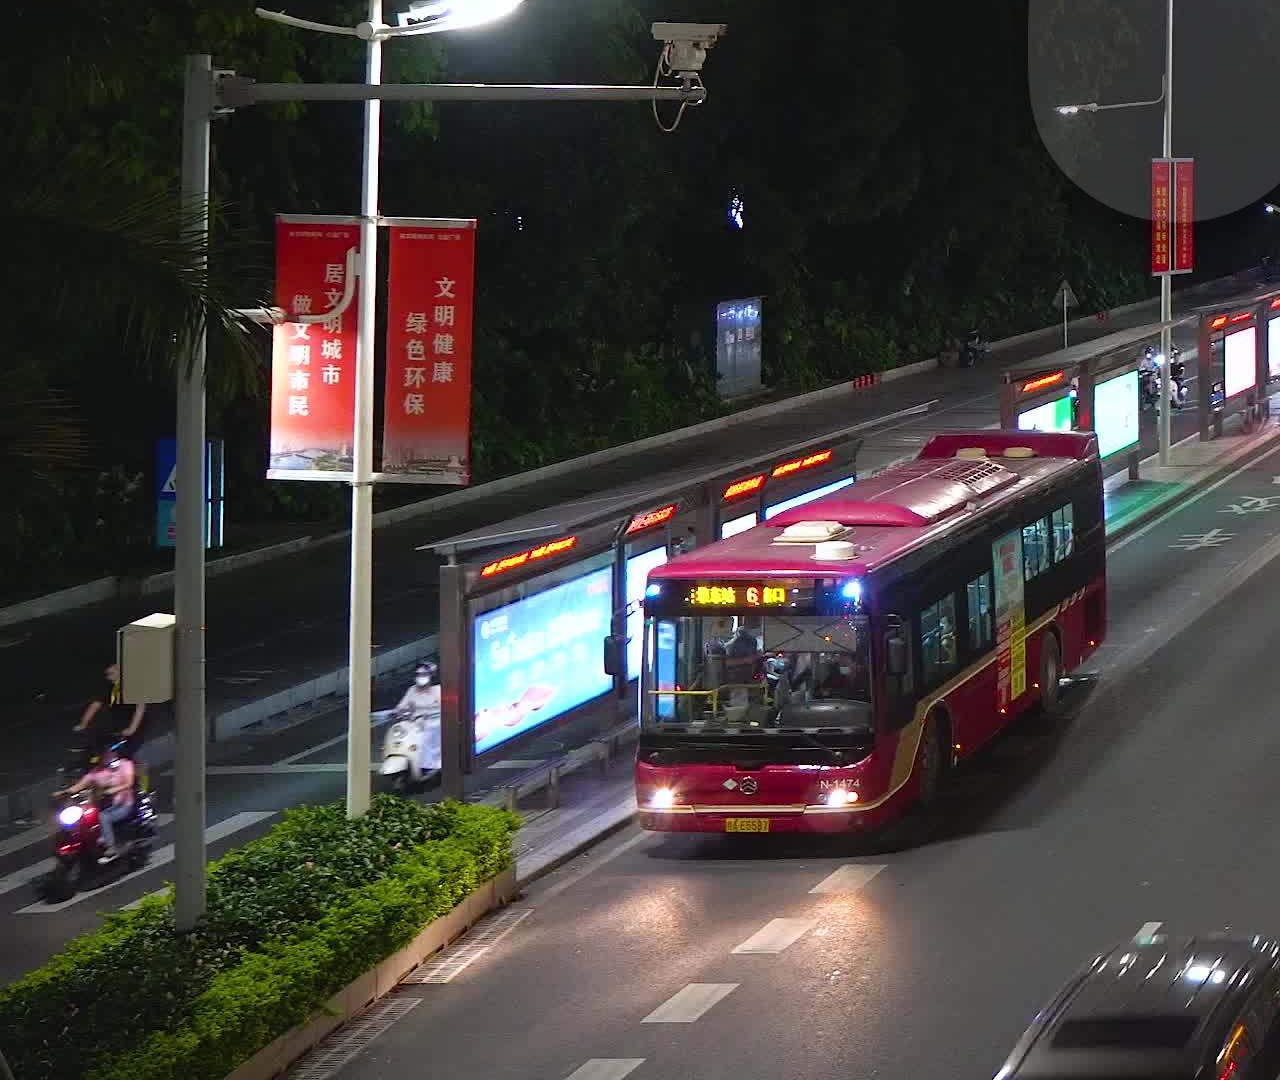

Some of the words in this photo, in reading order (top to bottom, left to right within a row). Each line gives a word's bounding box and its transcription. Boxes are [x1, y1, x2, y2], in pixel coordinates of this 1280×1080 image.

[287, 294, 313, 417] 做文明市民
[321, 263, 344, 385] 居文明城市
[403, 311, 428, 415] 绿色环保
[432, 276, 456, 384] 文明健康
[746, 587, 759, 603] 6
[820, 779, 861, 790] N-1474
